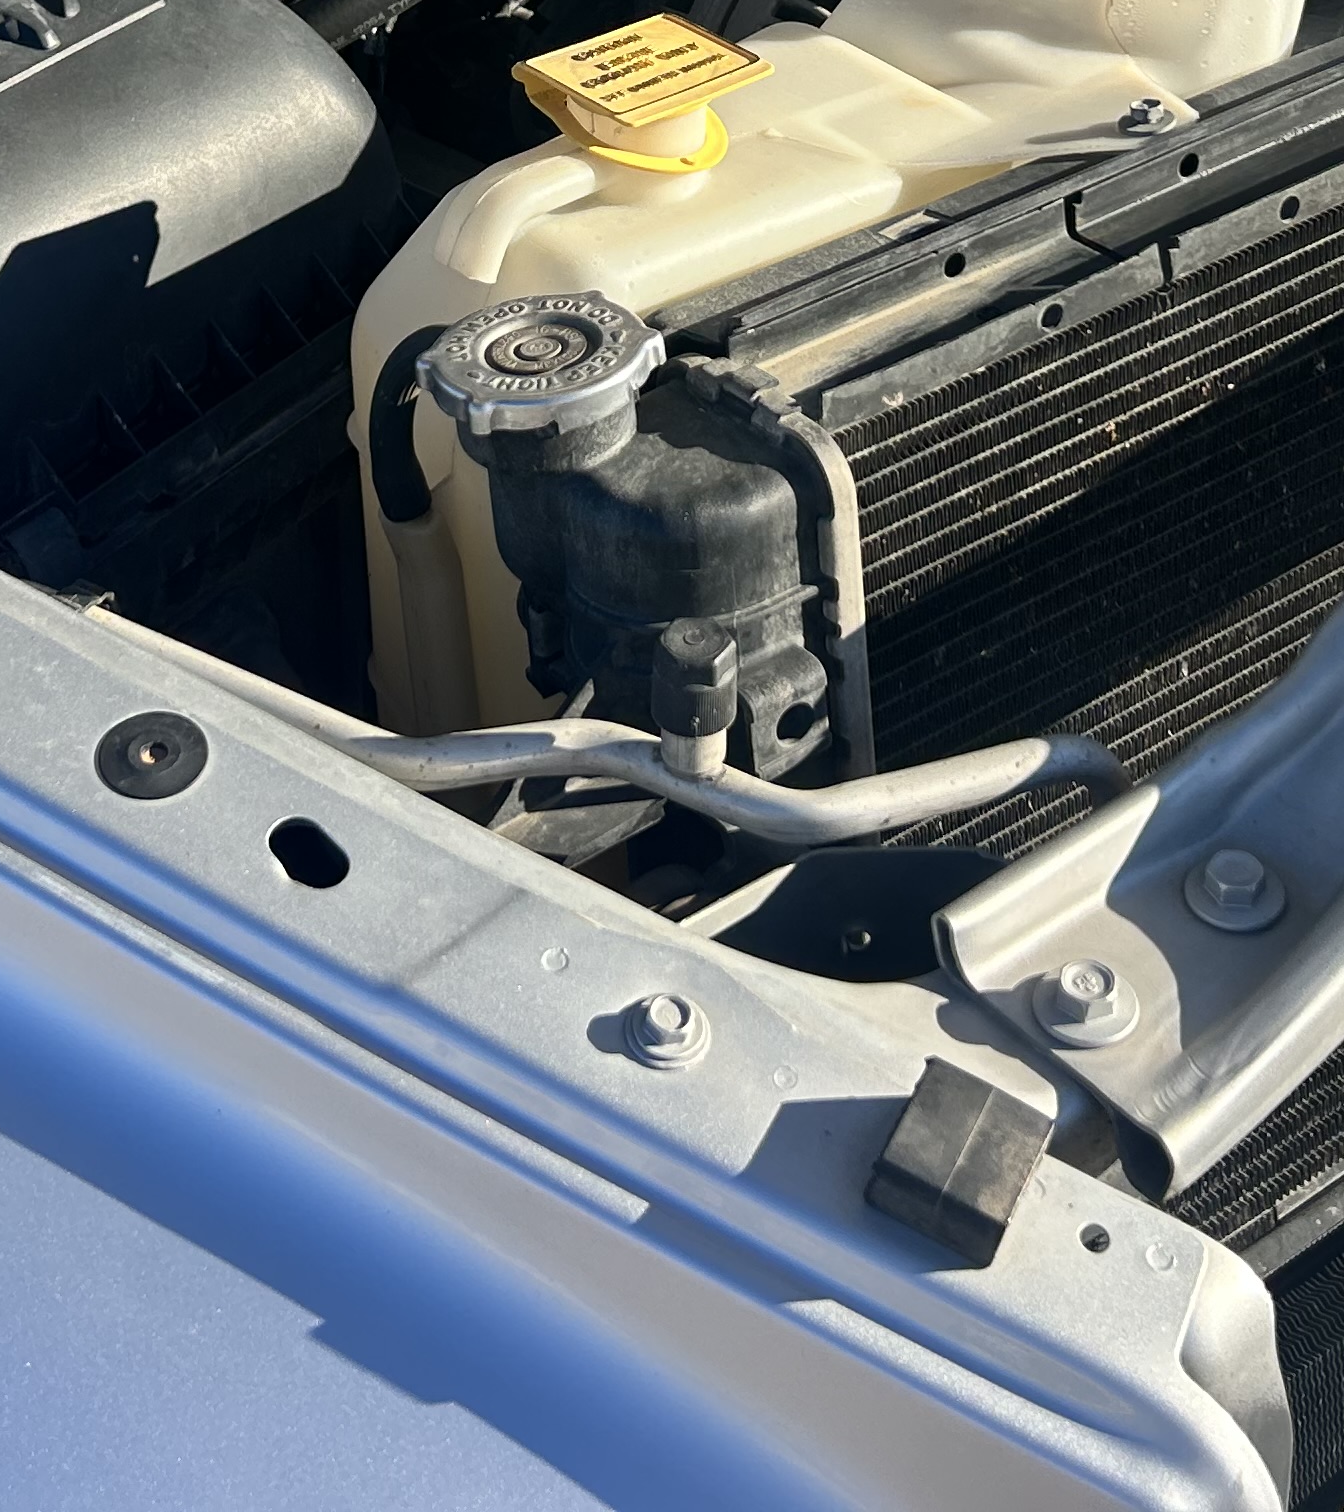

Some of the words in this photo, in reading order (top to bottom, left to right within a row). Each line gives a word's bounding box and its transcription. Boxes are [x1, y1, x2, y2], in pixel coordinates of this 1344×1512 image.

[466, 301, 527, 335] OPEN
[537, 298, 591, 314] NOT
[587, 305, 623, 326] DO
[445, 333, 472, 362] HOT
[565, 344, 627, 383] KEEP
[476, 374, 564, 392] TIGHT
